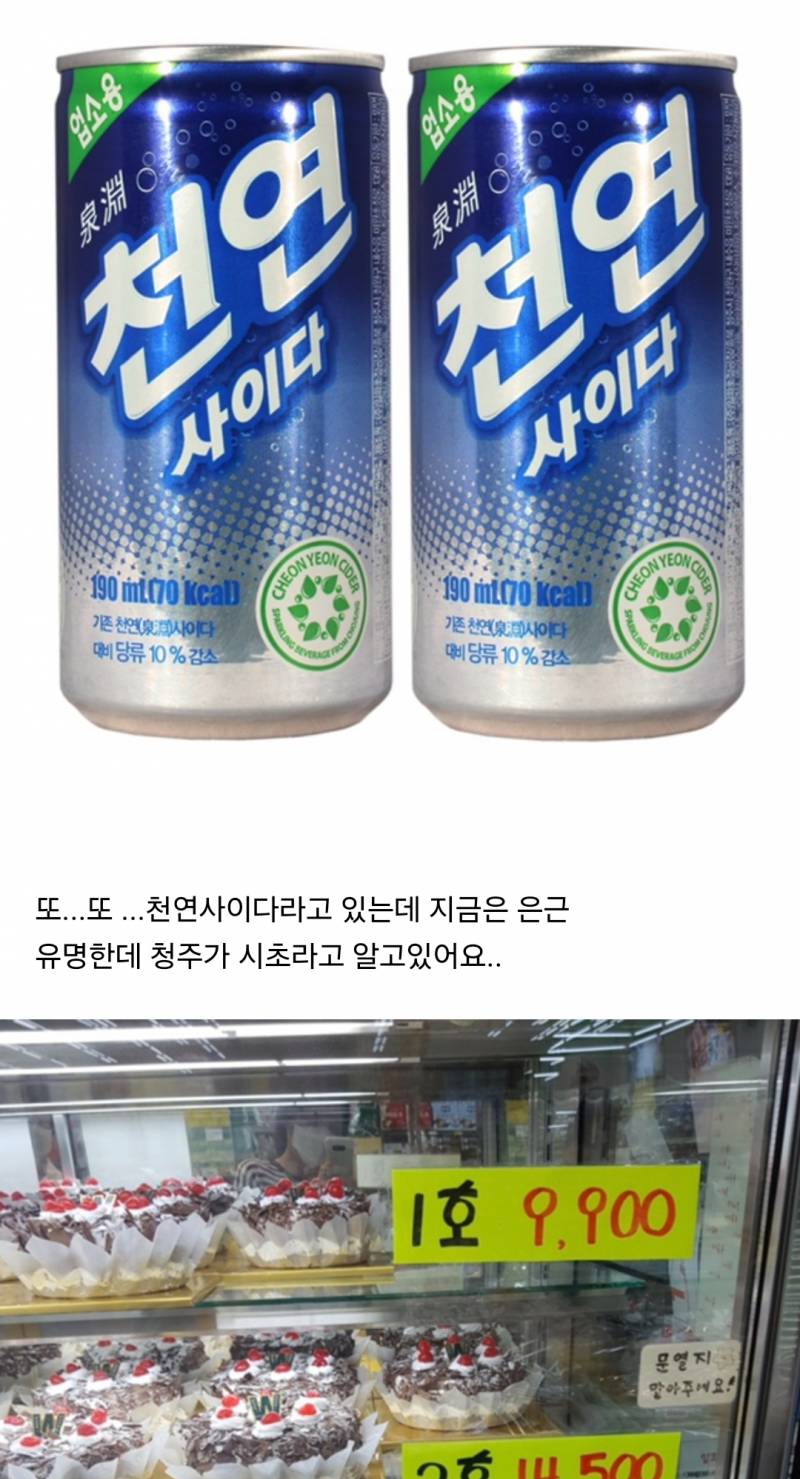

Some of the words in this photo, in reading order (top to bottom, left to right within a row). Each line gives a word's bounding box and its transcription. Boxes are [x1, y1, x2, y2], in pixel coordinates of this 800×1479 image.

[70, 72, 124, 150] 업소용
[421, 73, 476, 151] 업소용
[80, 169, 127, 248] 泉淵
[432, 170, 480, 250] 泉淵
[83, 92, 353, 421] 천연
[435, 93, 705, 422] 천연
[170, 311, 326, 477] 사이다
[522, 312, 678, 478] 사이다
[91, 574, 118, 601] 190
[272, 556, 308, 601] CHEON
[305, 551, 340, 567] YEON
[338, 558, 360, 594] CIDER
[443, 575, 470, 603] 190
[624, 558, 660, 602] CHEON
[657, 552, 692, 569] YEON
[690, 560, 713, 596] CIDER
[115, 641, 146, 664] 당류
[149, 646, 166, 663] 10
[188, 648, 220, 666] 감소
[468, 643, 498, 666] 당류
[501, 647, 519, 665] 10
[541, 649, 572, 667] 감소
[411, 1179, 480, 1248] 1호
[522, 1186, 677, 1250] 9,900
